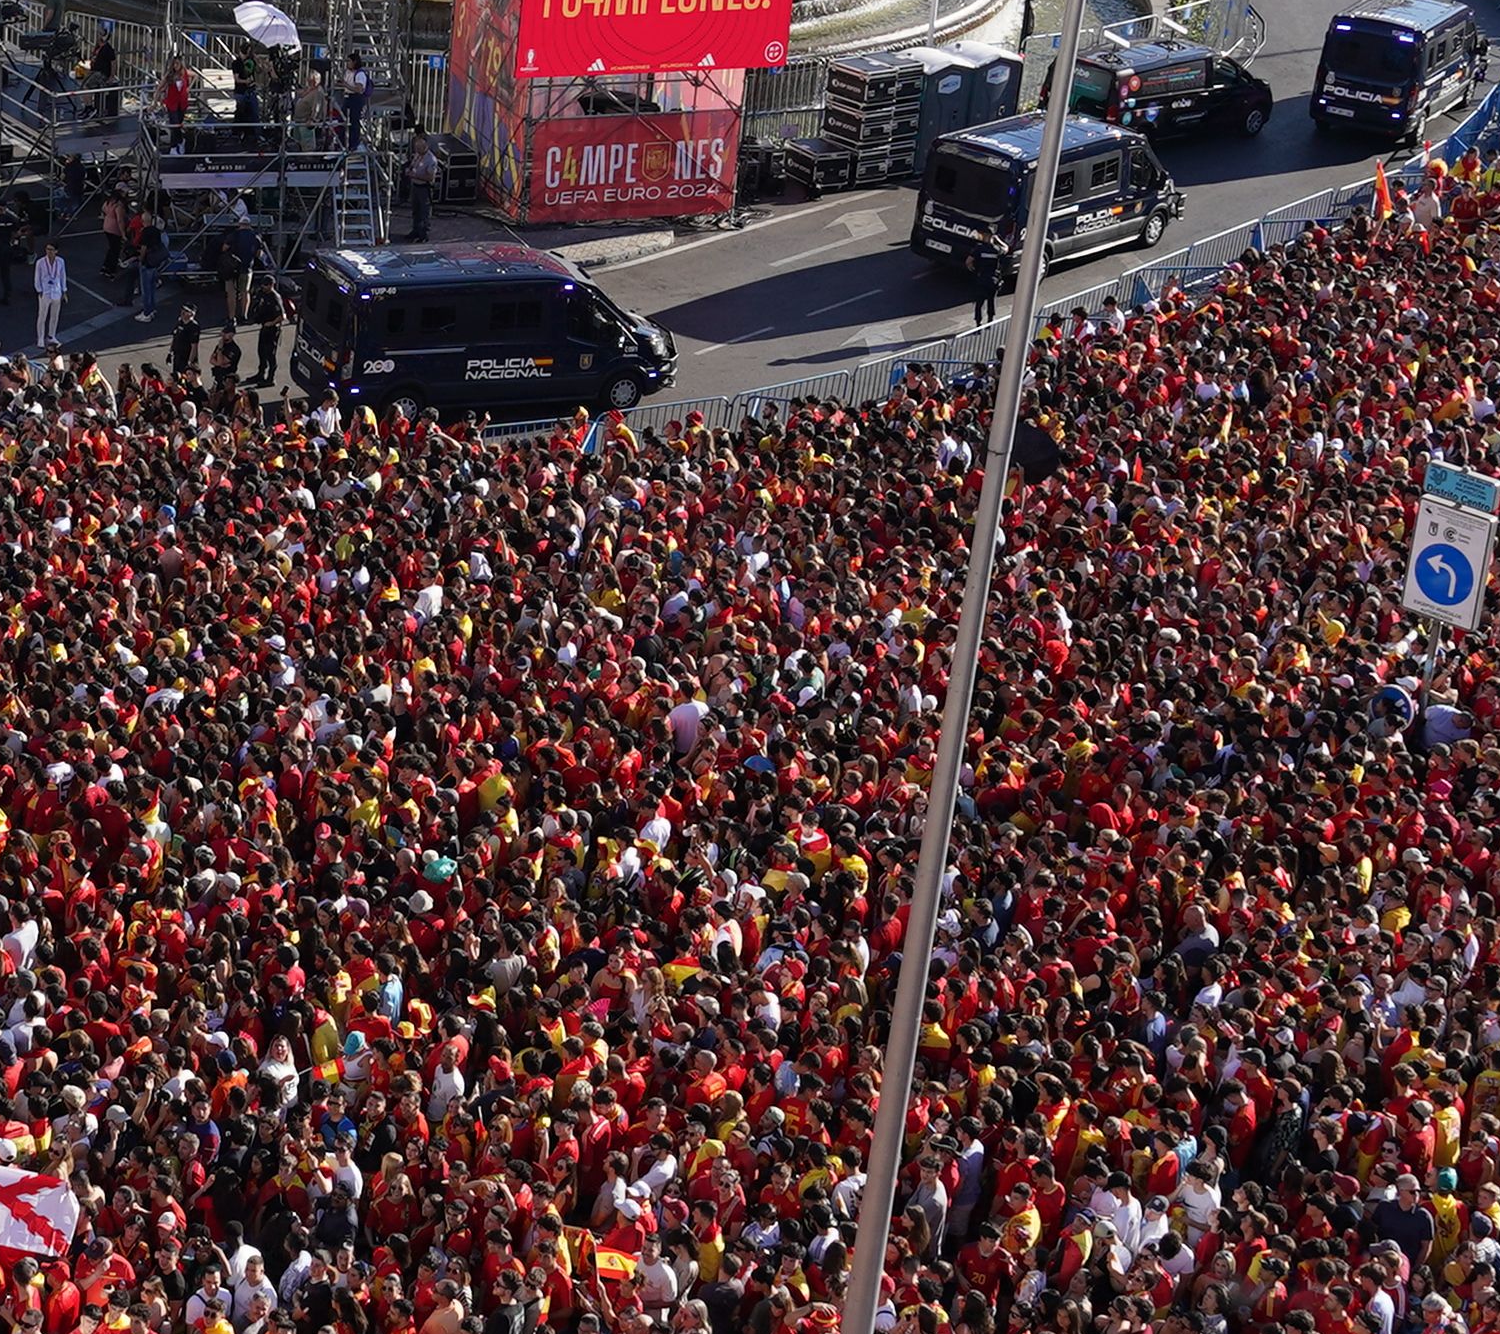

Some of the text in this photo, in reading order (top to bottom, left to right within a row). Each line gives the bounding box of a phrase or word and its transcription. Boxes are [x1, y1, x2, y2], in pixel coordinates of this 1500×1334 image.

[1322, 83, 1383, 104] POLICIA
[544, 142, 638, 189] C4MPE
[544, 184, 720, 206] UEFA EURO 2024
[922, 214, 979, 239] POLICIA
[465, 367, 553, 381] NACIONAL
[466, 357, 536, 369] POLICIA
[1426, 483, 1459, 501] Distrito
[1460, 495, 1491, 513] Centro
